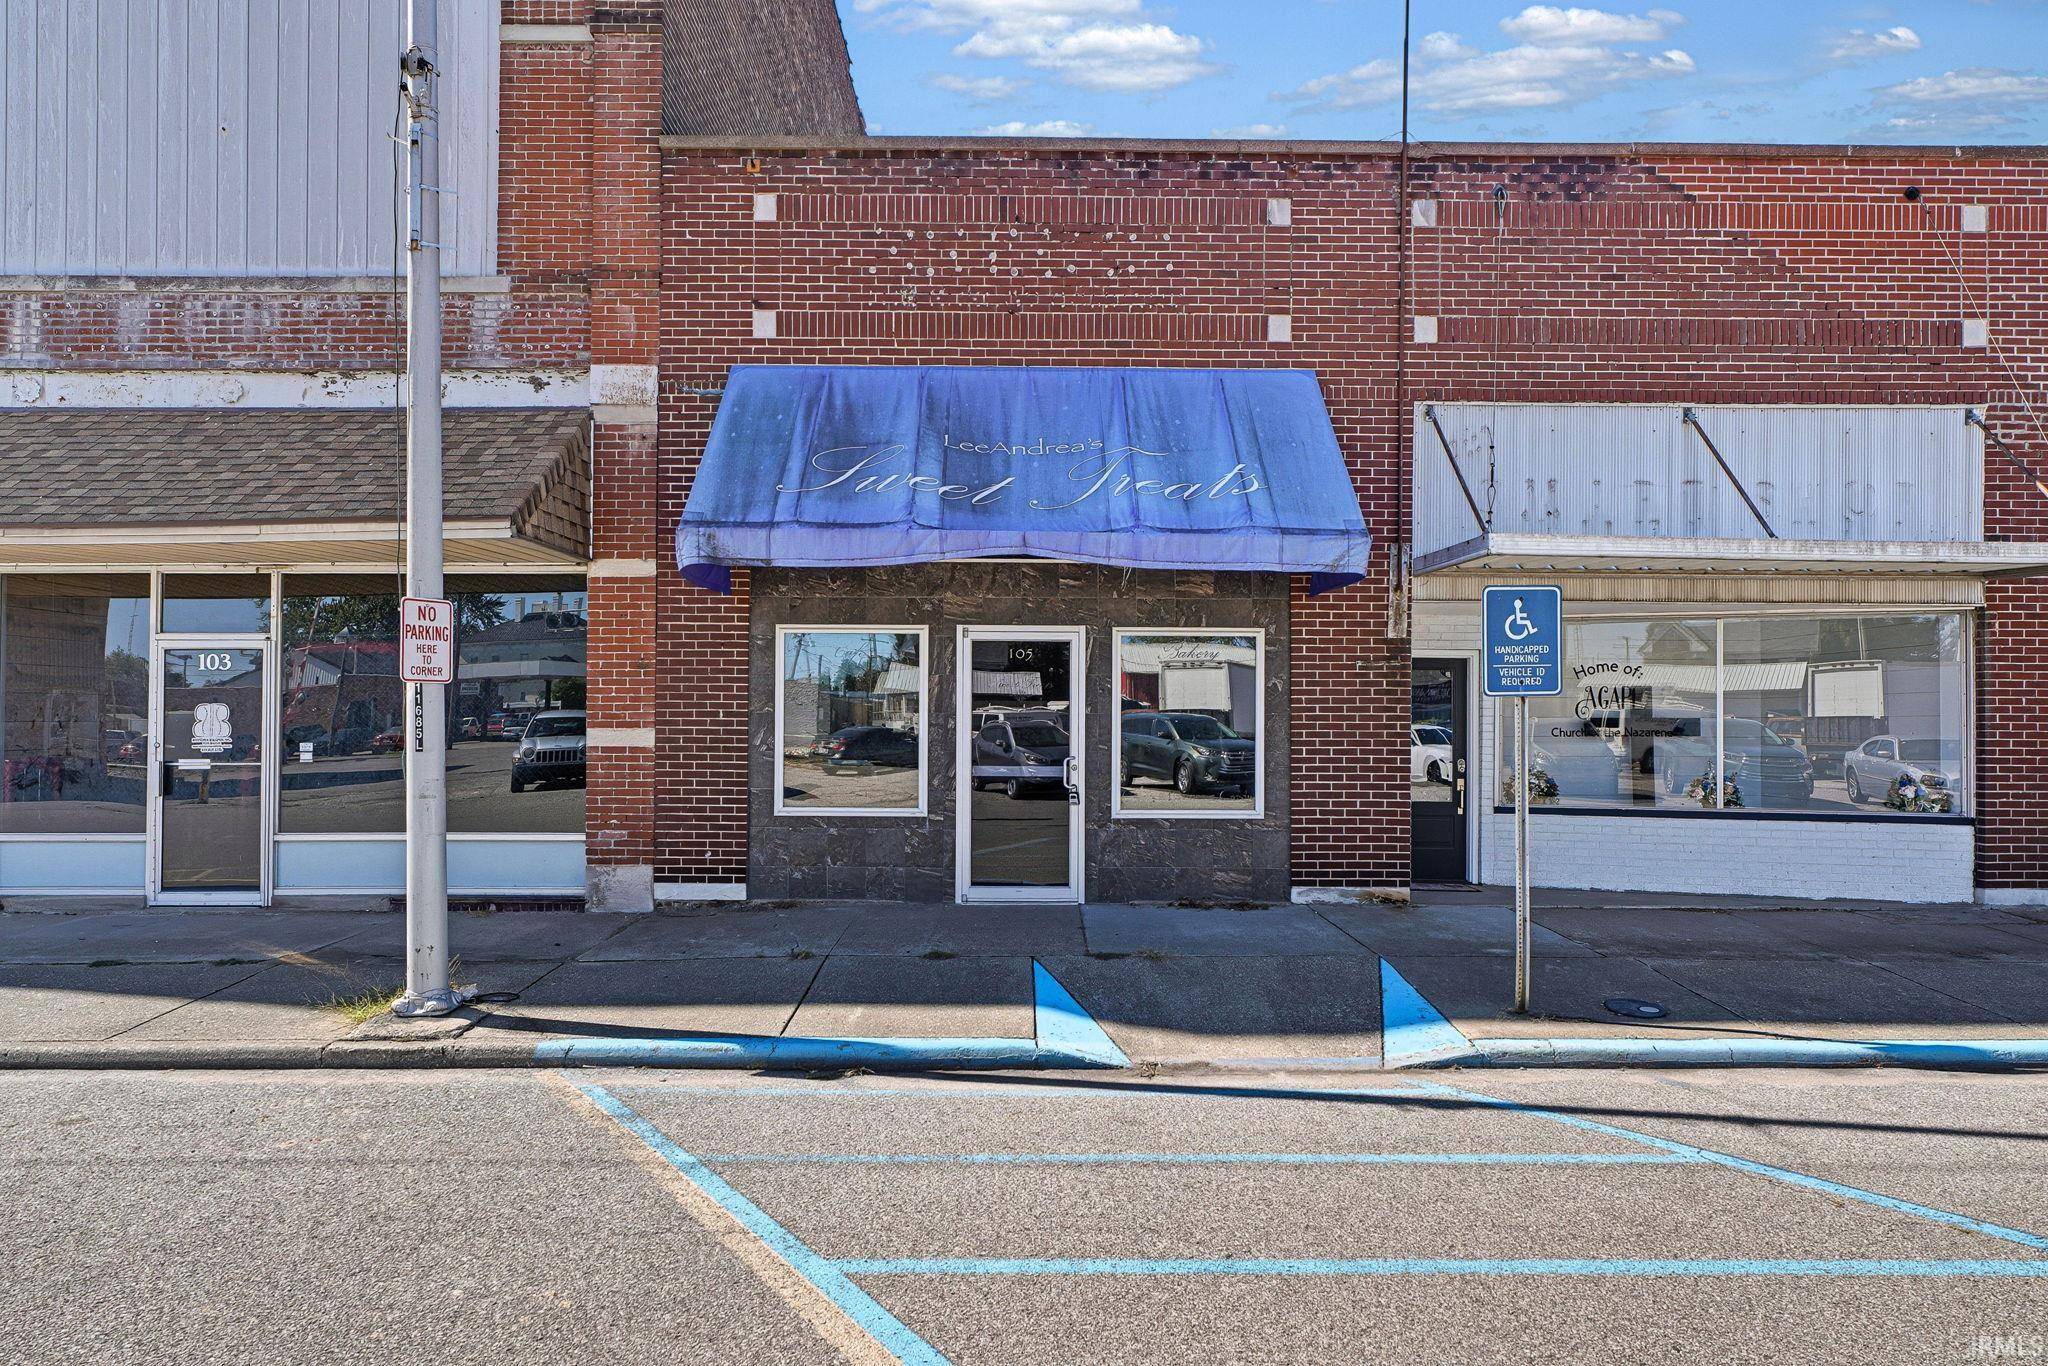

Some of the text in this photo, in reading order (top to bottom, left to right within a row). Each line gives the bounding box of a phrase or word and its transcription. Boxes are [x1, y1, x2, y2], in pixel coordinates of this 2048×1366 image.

[943, 434, 1105, 456] LeeAndrea's
[776, 444, 1268, 509] Sweet Treats
[417, 605, 437, 622] NO
[405, 624, 449, 642] PARKING
[416, 643, 438, 654] HERE
[1009, 648, 1033, 661] 105
[1158, 641, 1221, 661] Bakery
[1494, 645, 1549, 654] HANDICAPPED
[198, 653, 232, 671] 103
[422, 655, 432, 665] TO
[1504, 655, 1539, 663] PARKING
[410, 665, 443, 676] CORNER
[1499, 667, 1545, 676] VEHICLE ID
[1573, 662, 1643, 680] Home of:
[1624, 727, 1674, 738] Nazarene
